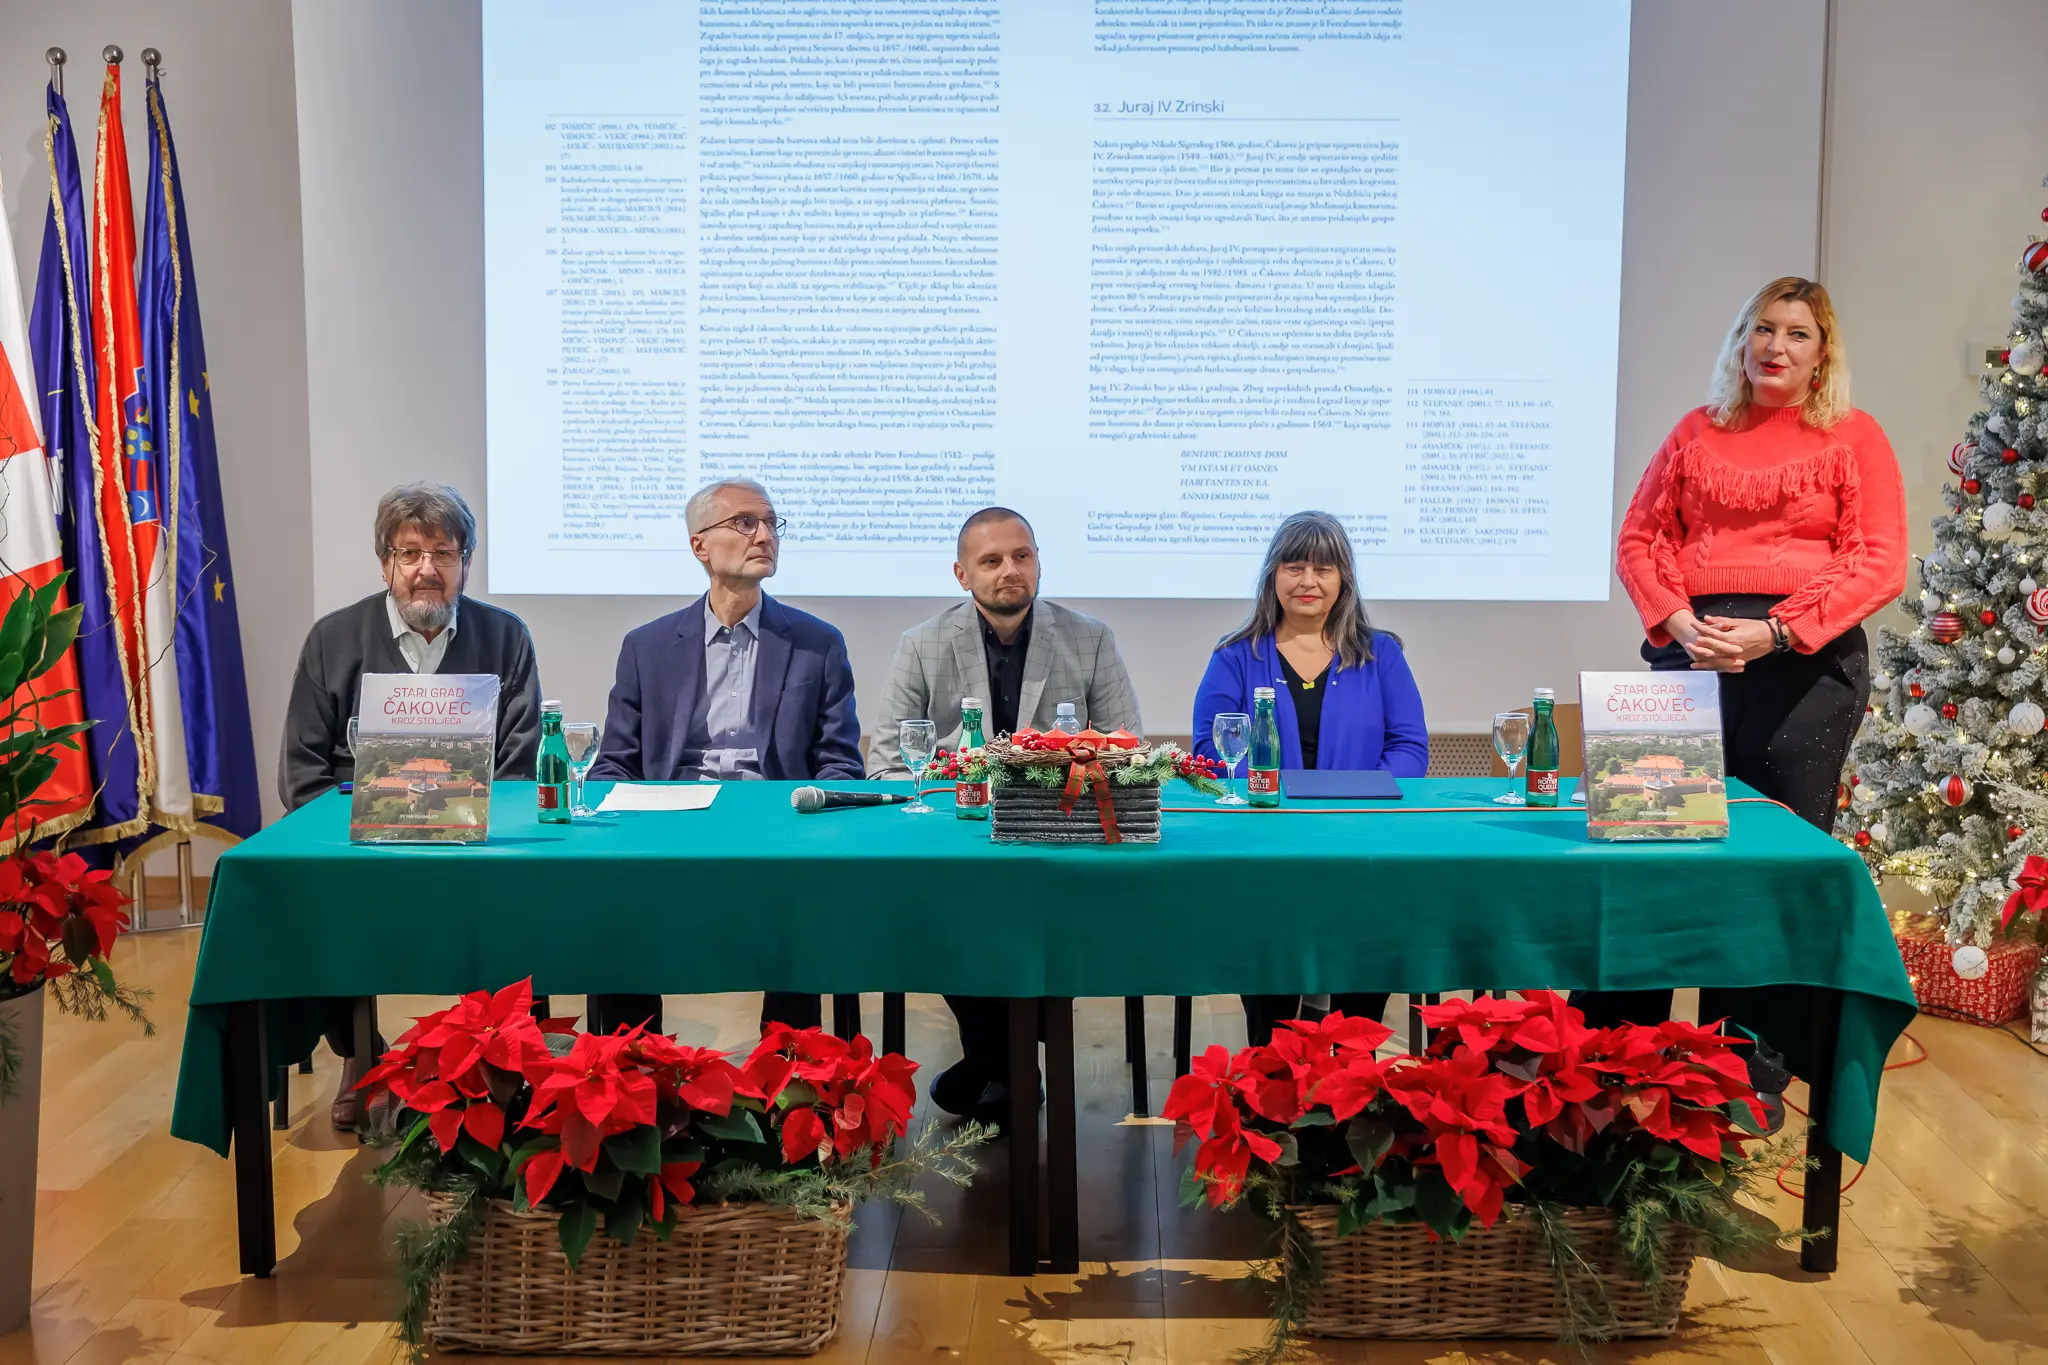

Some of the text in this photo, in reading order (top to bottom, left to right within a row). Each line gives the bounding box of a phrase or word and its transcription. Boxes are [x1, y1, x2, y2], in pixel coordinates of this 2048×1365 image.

[1117, 100, 1154, 115] Juraj
[1158, 100, 1173, 113] IV.
[1176, 99, 1225, 113] Zrinski
[1181, 451, 1288, 459] BENEDIC DOMINE DOM
[393, 688, 465, 697] STARI GRAD
[1613, 684, 1686, 694] STARI GRAD
[383, 696, 472, 715] ČAKOVEC
[1607, 693, 1696, 712] ČAKOVEC
[391, 716, 462, 725] KROZ STOLJEĆA
[1616, 714, 1641, 722] KROZ
